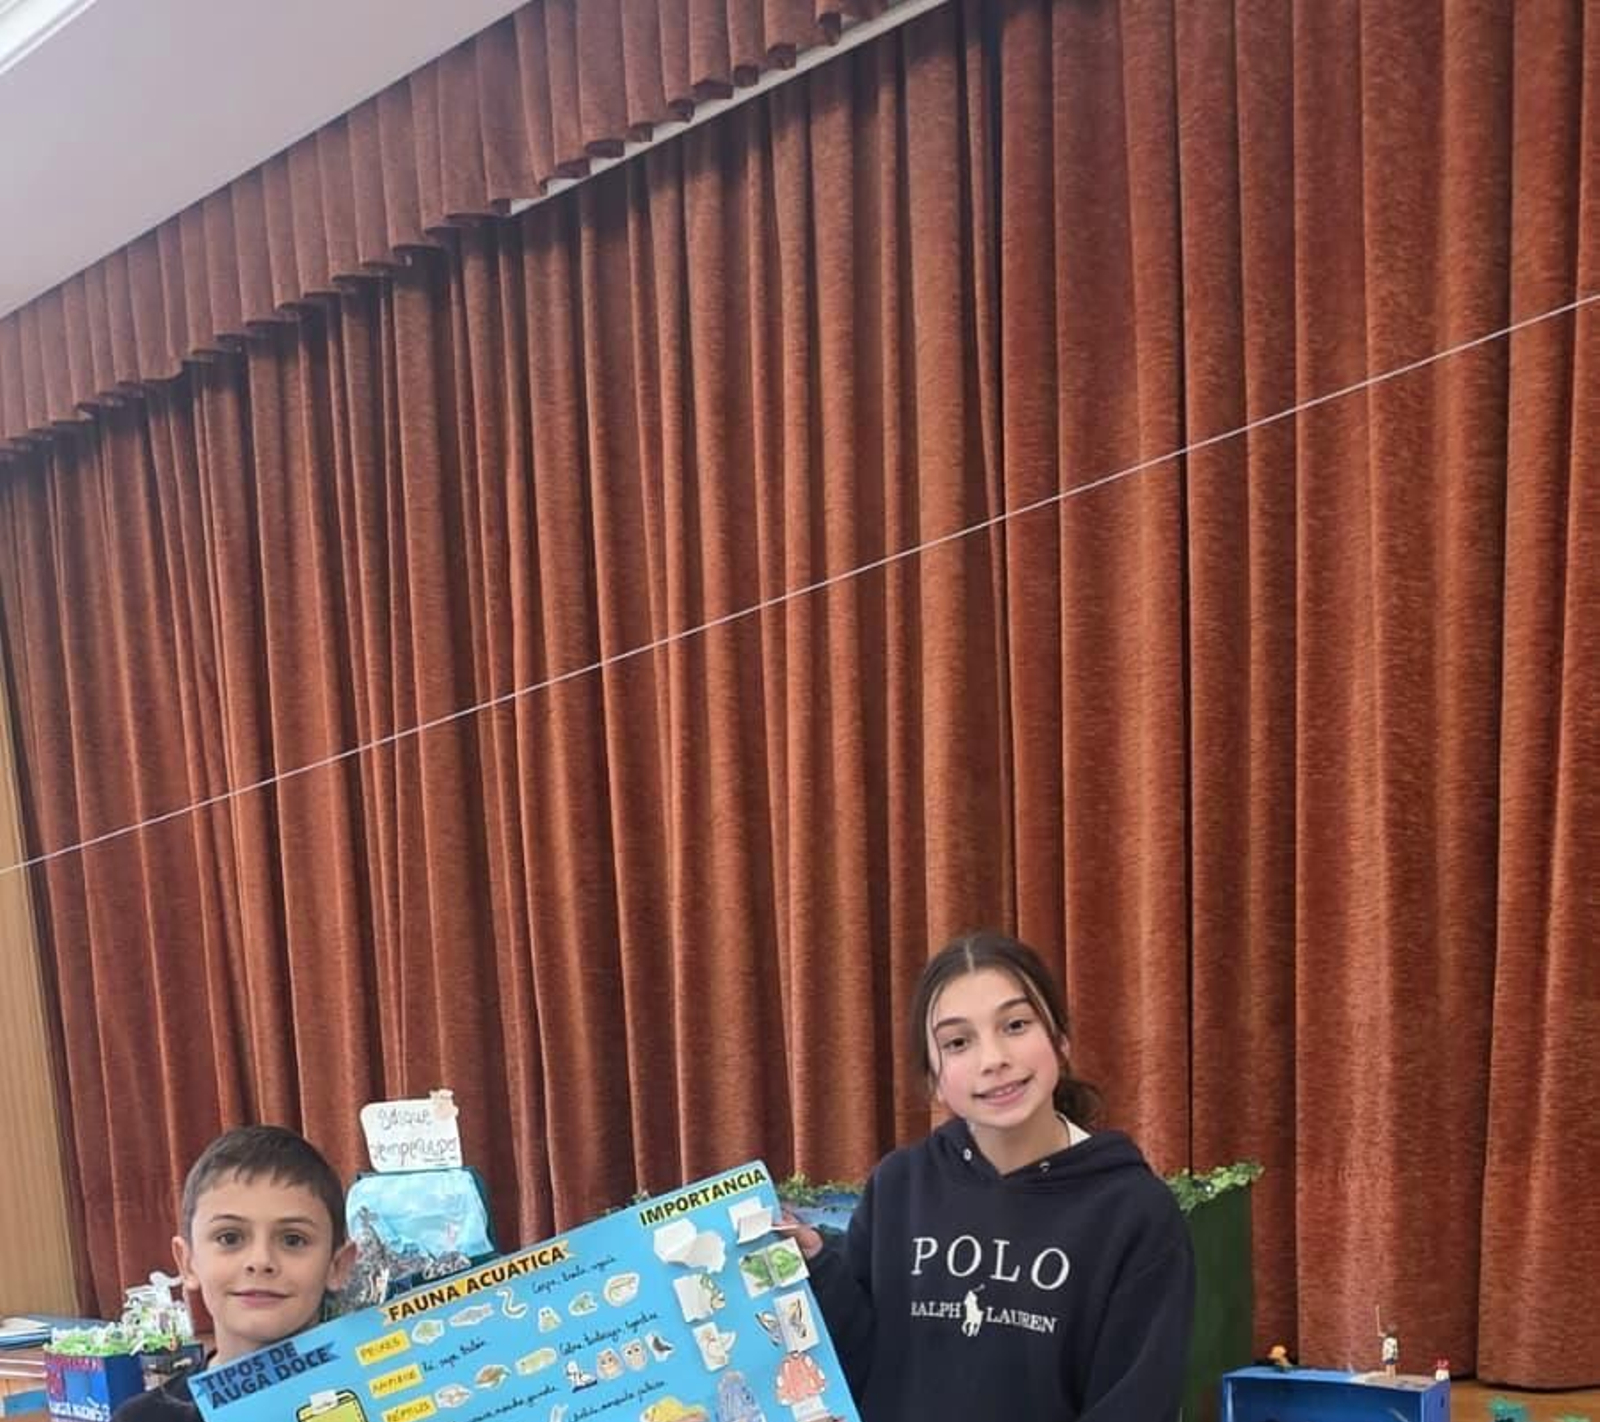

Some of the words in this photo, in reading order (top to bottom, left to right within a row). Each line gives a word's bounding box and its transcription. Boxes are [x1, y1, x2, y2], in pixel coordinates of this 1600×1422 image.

[640, 1168, 767, 1226] IMPORTANCIA
[388, 1285, 461, 1321] FAUNA
[466, 1246, 565, 1294] ACUATICA
[910, 1234, 1070, 1290] POLO
[985, 1306, 1058, 1333] LAUREN
[201, 1356, 265, 1391] TIPOS
[268, 1341, 298, 1364] DE
[211, 1373, 272, 1410] AUGA
[275, 1347, 330, 1381] DOCE
